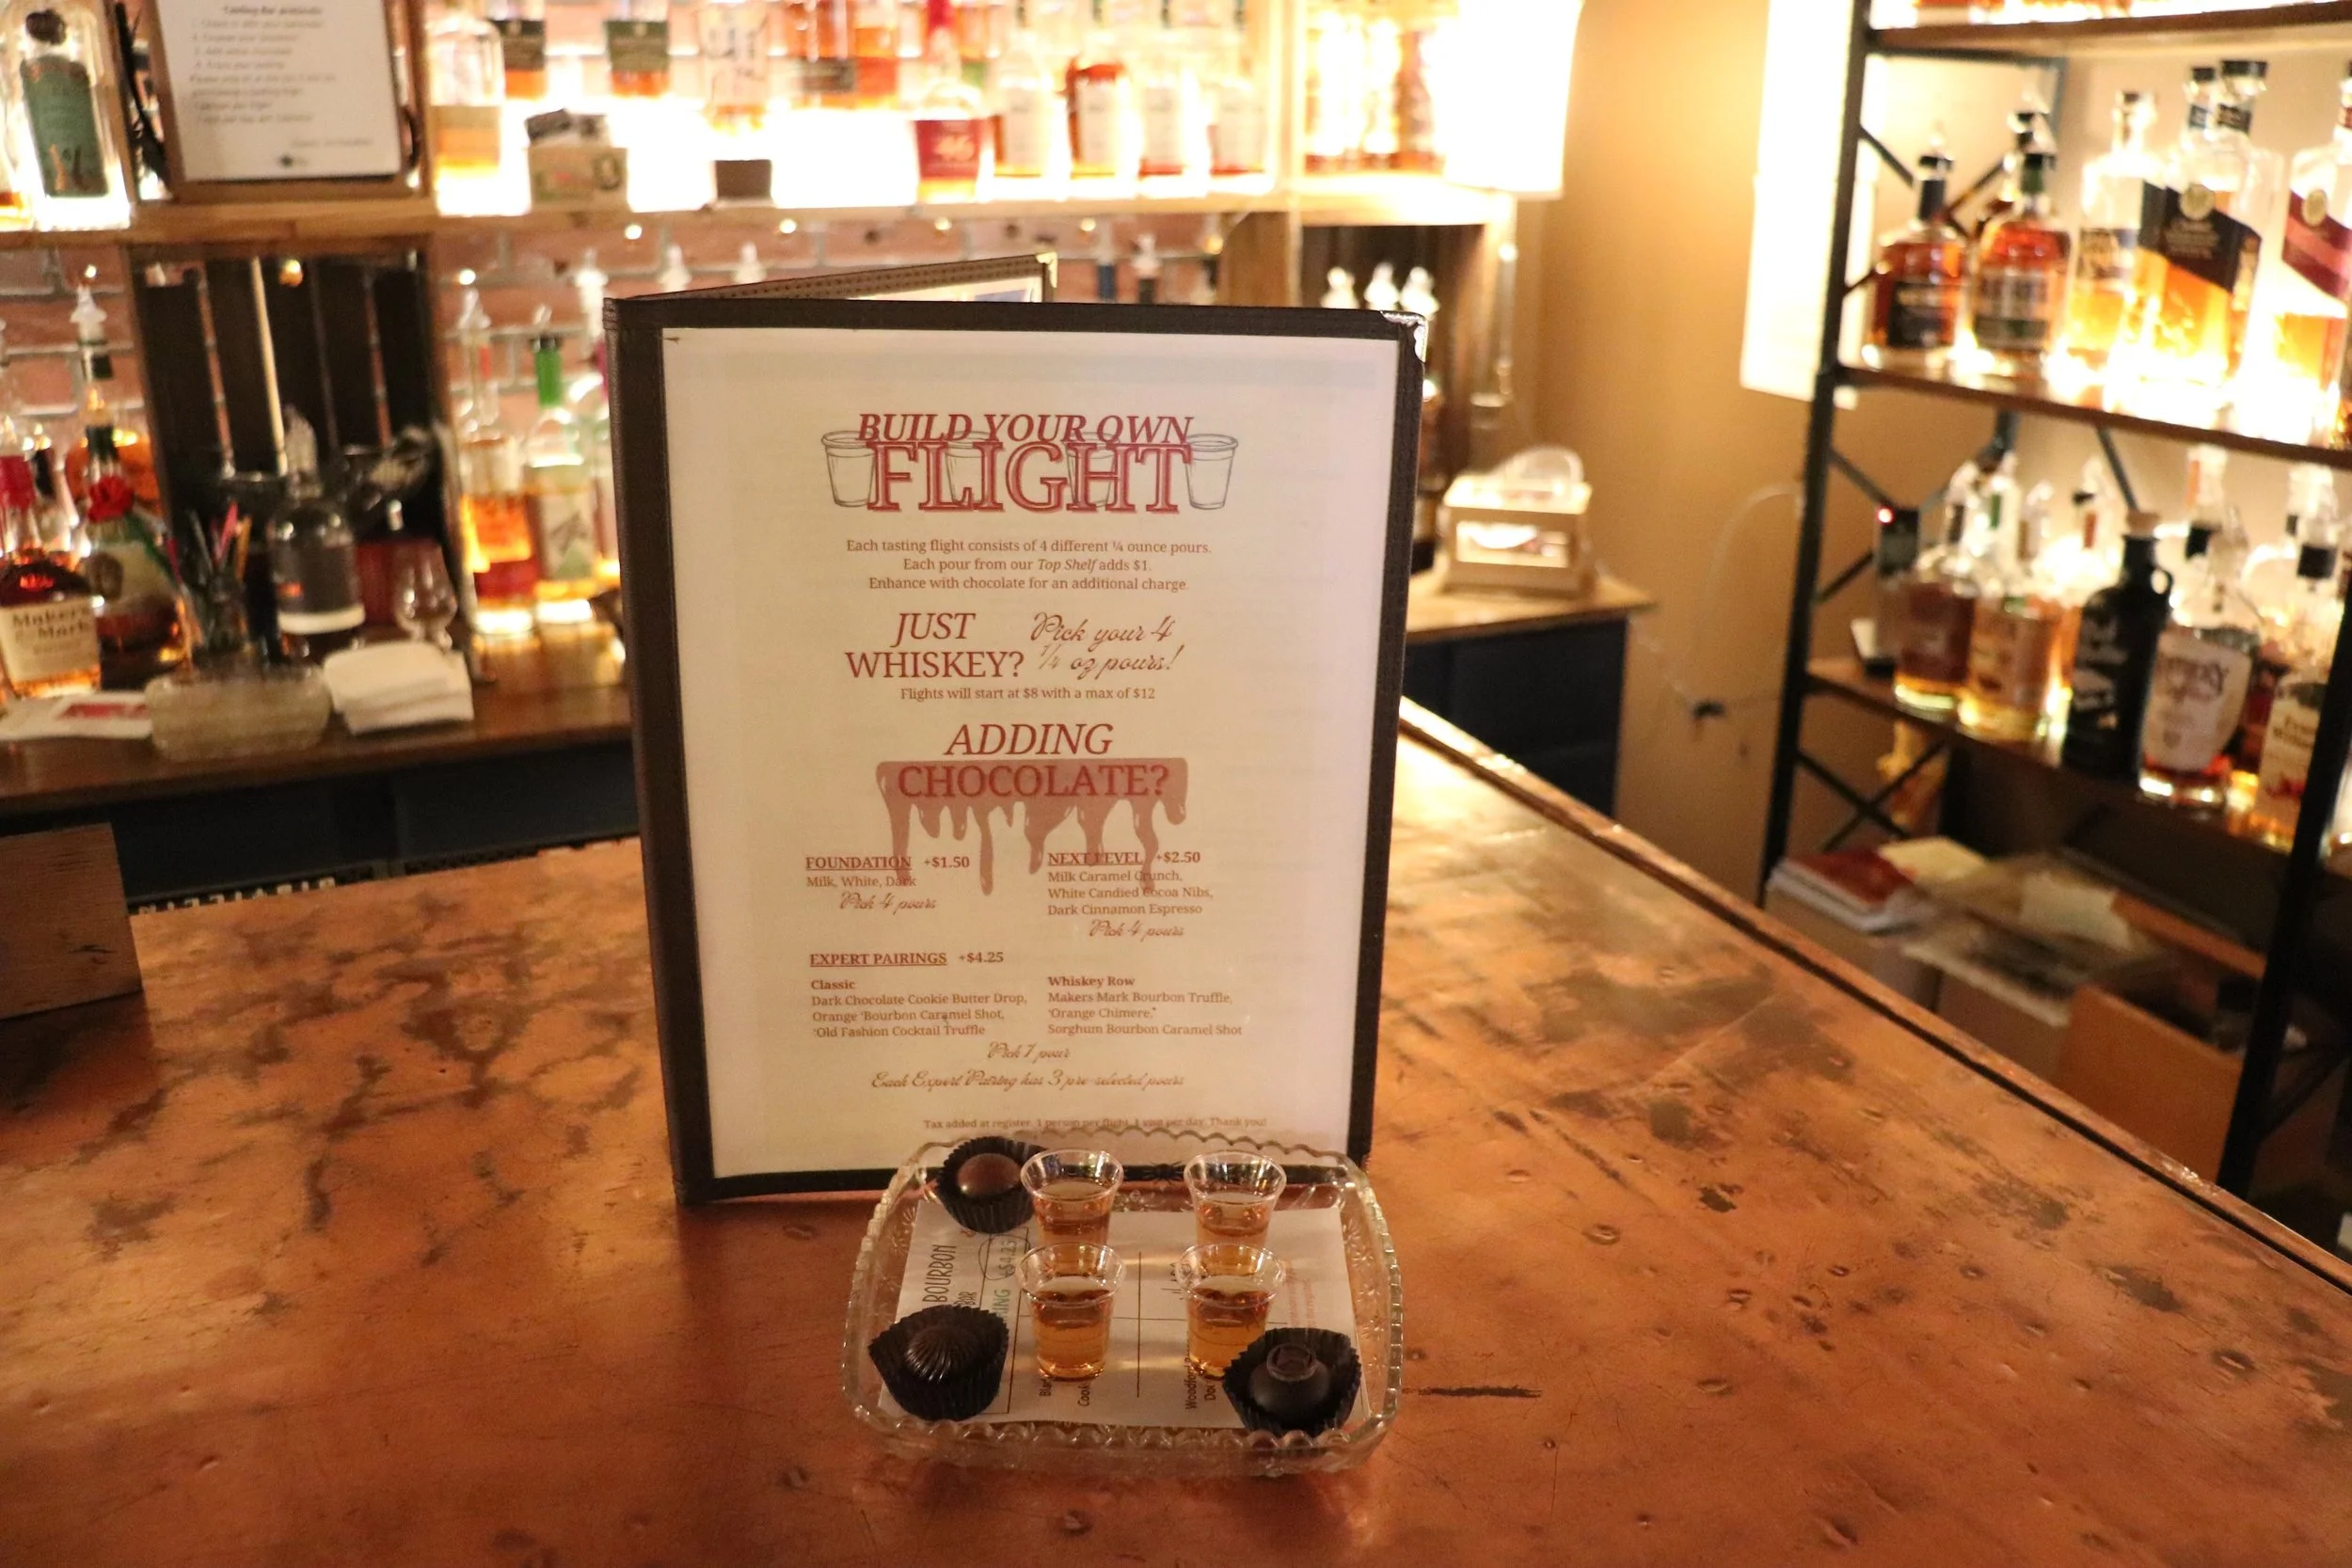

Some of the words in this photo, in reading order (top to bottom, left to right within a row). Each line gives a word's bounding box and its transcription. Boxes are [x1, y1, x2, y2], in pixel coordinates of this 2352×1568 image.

[858, 413, 973, 442] BUILD
[985, 414, 1087, 443] YOUR
[1097, 416, 1194, 444] OWN
[866, 440, 1194, 514] FLIGHT
[846, 539, 878, 552] Each
[882, 540, 926, 554] tasting
[930, 539, 964, 554] flight
[968, 540, 1020, 552] consists
[1024, 539, 1038, 552] of
[1040, 540, 1047, 552] 4
[1051, 540, 1108, 552] different
[1127, 543, 1168, 553] ounce
[1170, 543, 1212, 556] pours.
[904, 558, 935, 570] Each
[939, 560, 971, 573] pour
[975, 558, 1007, 570] from
[1010, 560, 1033, 570] our
[1038, 560, 1061, 573] Top
[1065, 559, 1097, 574] Shelf
[1099, 560, 1130, 571] adds
[869, 578, 926, 590] Enhance
[930, 578, 960, 589] with
[963, 578, 1025, 590] chocolate
[1029, 578, 1047, 589] for
[1052, 579, 1068, 589] an
[1072, 578, 1137, 590] additional
[891, 612, 976, 648] JUST
[1030, 611, 1089, 641] Pick
[1088, 626, 1145, 653] your
[1151, 615, 1175, 642] 4
[845, 651, 1025, 679] WHISKEY?
[1071, 657, 1096, 680] oz
[1094, 644, 1184, 680] pours!
[901, 688, 944, 701] Flights
[947, 688, 971, 699] will
[975, 689, 1004, 700] start
[1008, 689, 1019, 699] at
[1023, 688, 1039, 700] $8
[1041, 688, 1071, 699] with
[1074, 690, 1082, 699] a
[1086, 690, 1113, 699] max
[1117, 688, 1130, 699] of
[1133, 688, 1155, 700] $12
[944, 723, 1114, 755] ADDING
[898, 764, 1169, 798] CHOCOLATE?
[805, 856, 912, 870] FOUNDATION
[924, 856, 970, 868] +$1.50
[1048, 852, 1090, 865] NEXT
[1093, 851, 1144, 865] LEVEL
[806, 876, 837, 888] Milk,
[841, 876, 882, 888] White,
[886, 876, 916, 887] Dark
[1048, 871, 1075, 882] Milk
[1079, 870, 1131, 882] Caramel
[1135, 870, 1183, 882] Crunch,
[1048, 888, 1087, 899] White
[1089, 887, 1139, 898] Candied
[1142, 887, 1179, 898] Cocoa
[1183, 887, 1214, 899] Nibs,
[839, 891, 876, 910] Pick
[879, 892, 894, 909] 4
[893, 897, 937, 915] pours
[1048, 905, 1078, 915] Dark
[1082, 904, 1145, 915] Cinnamon
[1149, 904, 1202, 917] Espresso
[1089, 919, 1125, 937] Pick
[1127, 920, 1141, 937] 4
[1140, 927, 1185, 942] pours
[810, 952, 869, 967] EXPERT
[873, 952, 947, 966] PAIRINGS
[811, 979, 855, 990] Classic
[1048, 976, 1104, 989] Whiskey
[1107, 976, 1136, 987] Row
[811, 995, 841, 1006] Dark
[845, 995, 905, 1006] Chocolate
[908, 994, 948, 1005] Cookie
[952, 993, 990, 1005] Butter
[993, 992, 1028, 1006] Drop,
[1048, 992, 1094, 1003] Makers
[1096, 992, 1129, 1003] Mark
[1133, 992, 1185, 1003] Bourbon
[812, 1011, 858, 1023] Orange
[920, 1009, 972, 1021] Caramel
[841, 1026, 889, 1037] Fashion
[892, 1025, 941, 1037] Cocktail
[944, 1023, 986, 1036] Truffle
[1048, 1024, 1103, 1036] Sorghum
[1106, 1024, 1159, 1035] Bourbon
[1162, 1024, 1213, 1035] Caramel
[1216, 1025, 1242, 1036] Shot
[988, 1041, 1023, 1058] Pick
[871, 1071, 909, 1087] Each
[1048, 1069, 1064, 1085] 3
[925, 1119, 943, 1129] Tax
[946, 1118, 977, 1129] added
[980, 1119, 990, 1129] at
[1044, 1119, 1079, 1131] person
[1210, 1117, 1242, 1127] Thank
[922, 1243, 957, 1303] BOURBON
